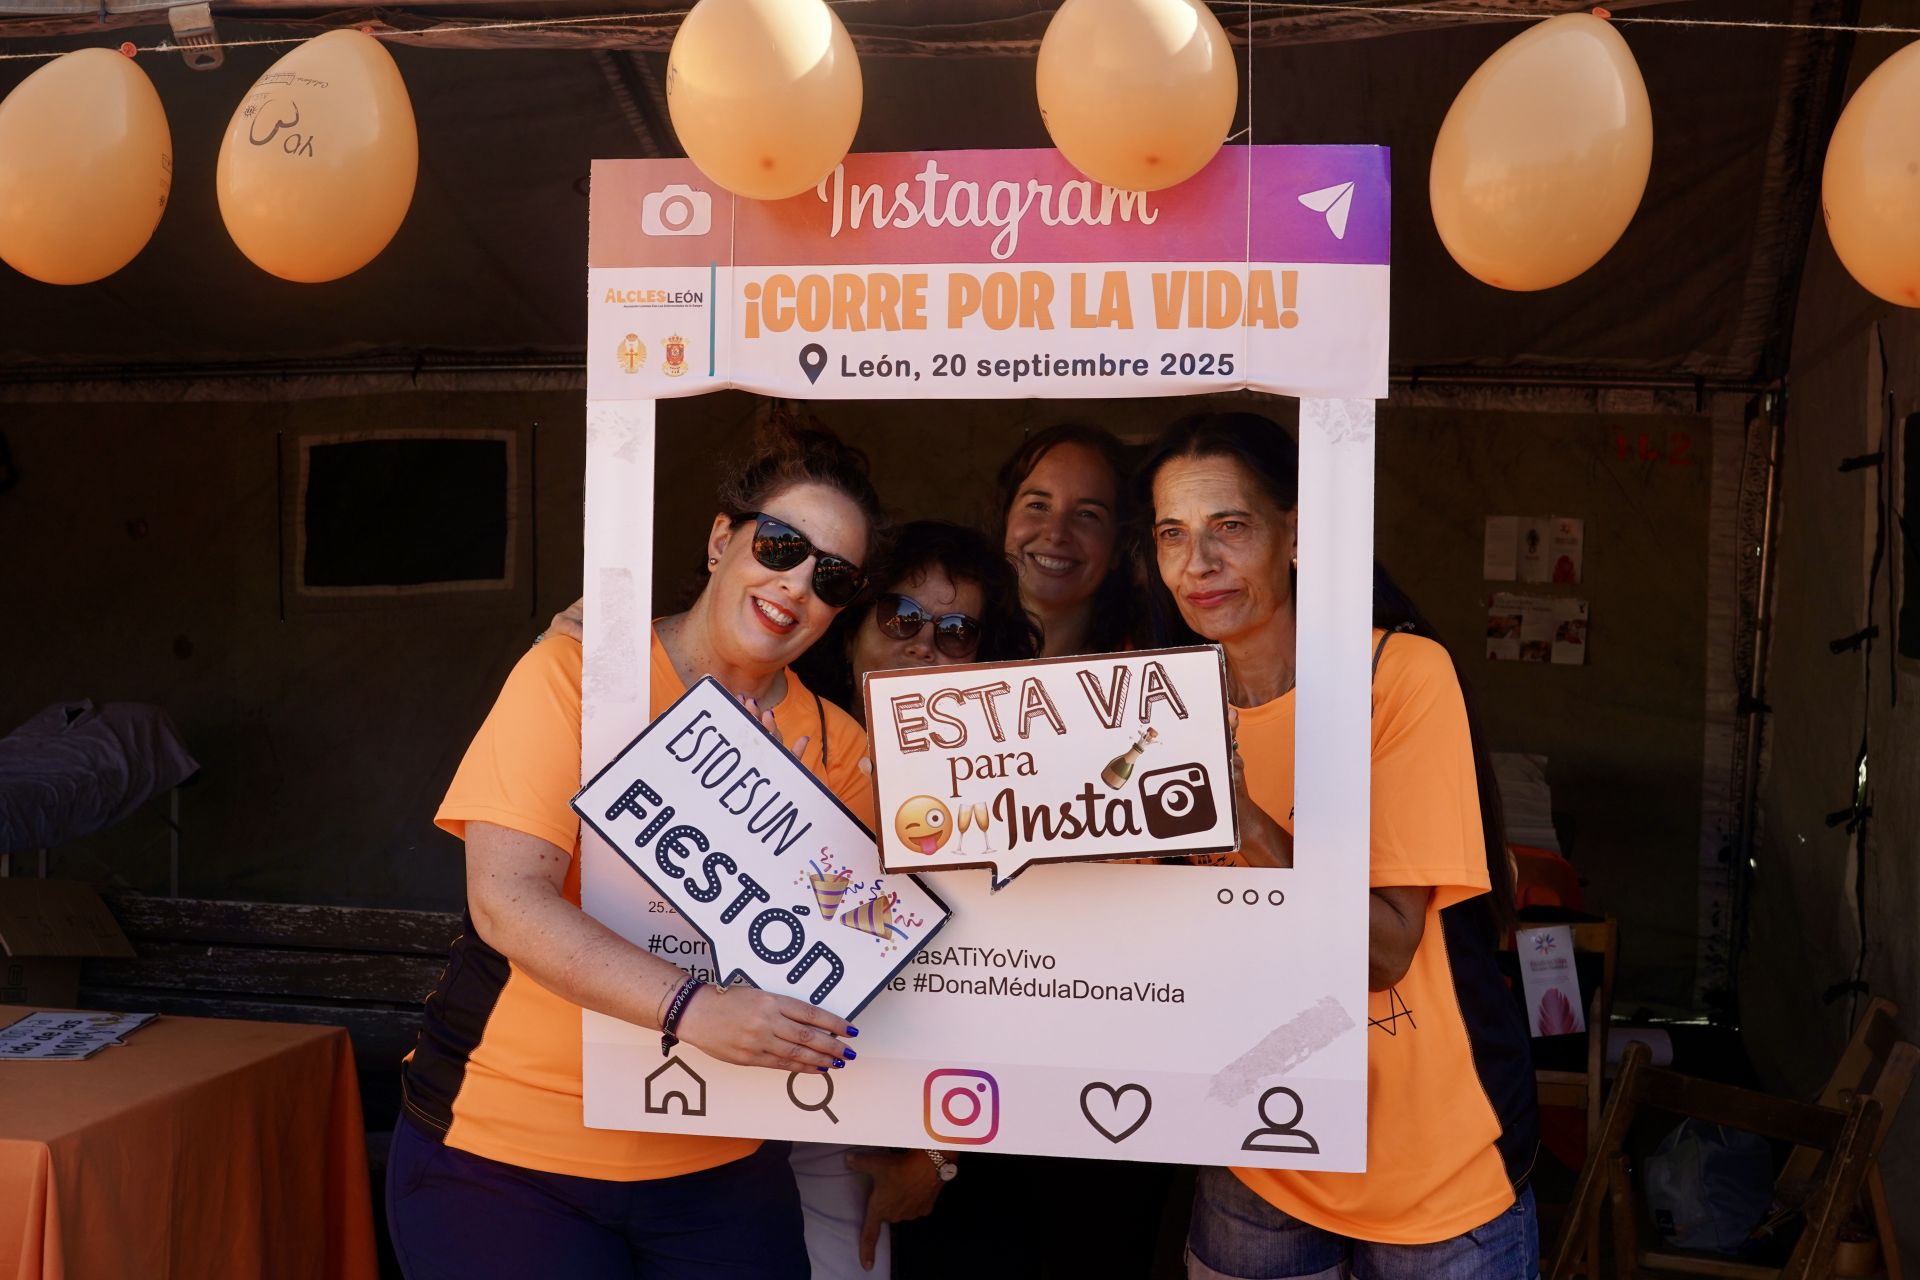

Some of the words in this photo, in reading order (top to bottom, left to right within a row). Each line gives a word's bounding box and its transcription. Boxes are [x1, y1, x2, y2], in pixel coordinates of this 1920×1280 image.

[283, 133, 314, 157] YO
[816, 159, 1159, 260] Instagram
[744, 272, 929, 338] ¡CORRE
[948, 270, 1055, 331] POR
[1070, 270, 1134, 330] LA
[1151, 270, 1300, 330] VIDA!
[841, 353, 921, 380] León,
[932, 353, 967, 377] 20
[977, 353, 1149, 383] septiembre
[1160, 352, 1236, 376] 2025
[890, 676, 1067, 754] ESTA
[1076, 660, 1189, 729] VA
[665, 709, 741, 789] ESTO
[718, 767, 771, 815] ES
[747, 791, 813, 857] UN
[946, 750, 1039, 799] para
[992, 782, 1142, 851] Insta
[648, 934, 708, 955] #Corr
[911, 946, 1056, 970] asATiYoVivo
[913, 973, 1185, 1004] #DonaMédulaDonaVida
